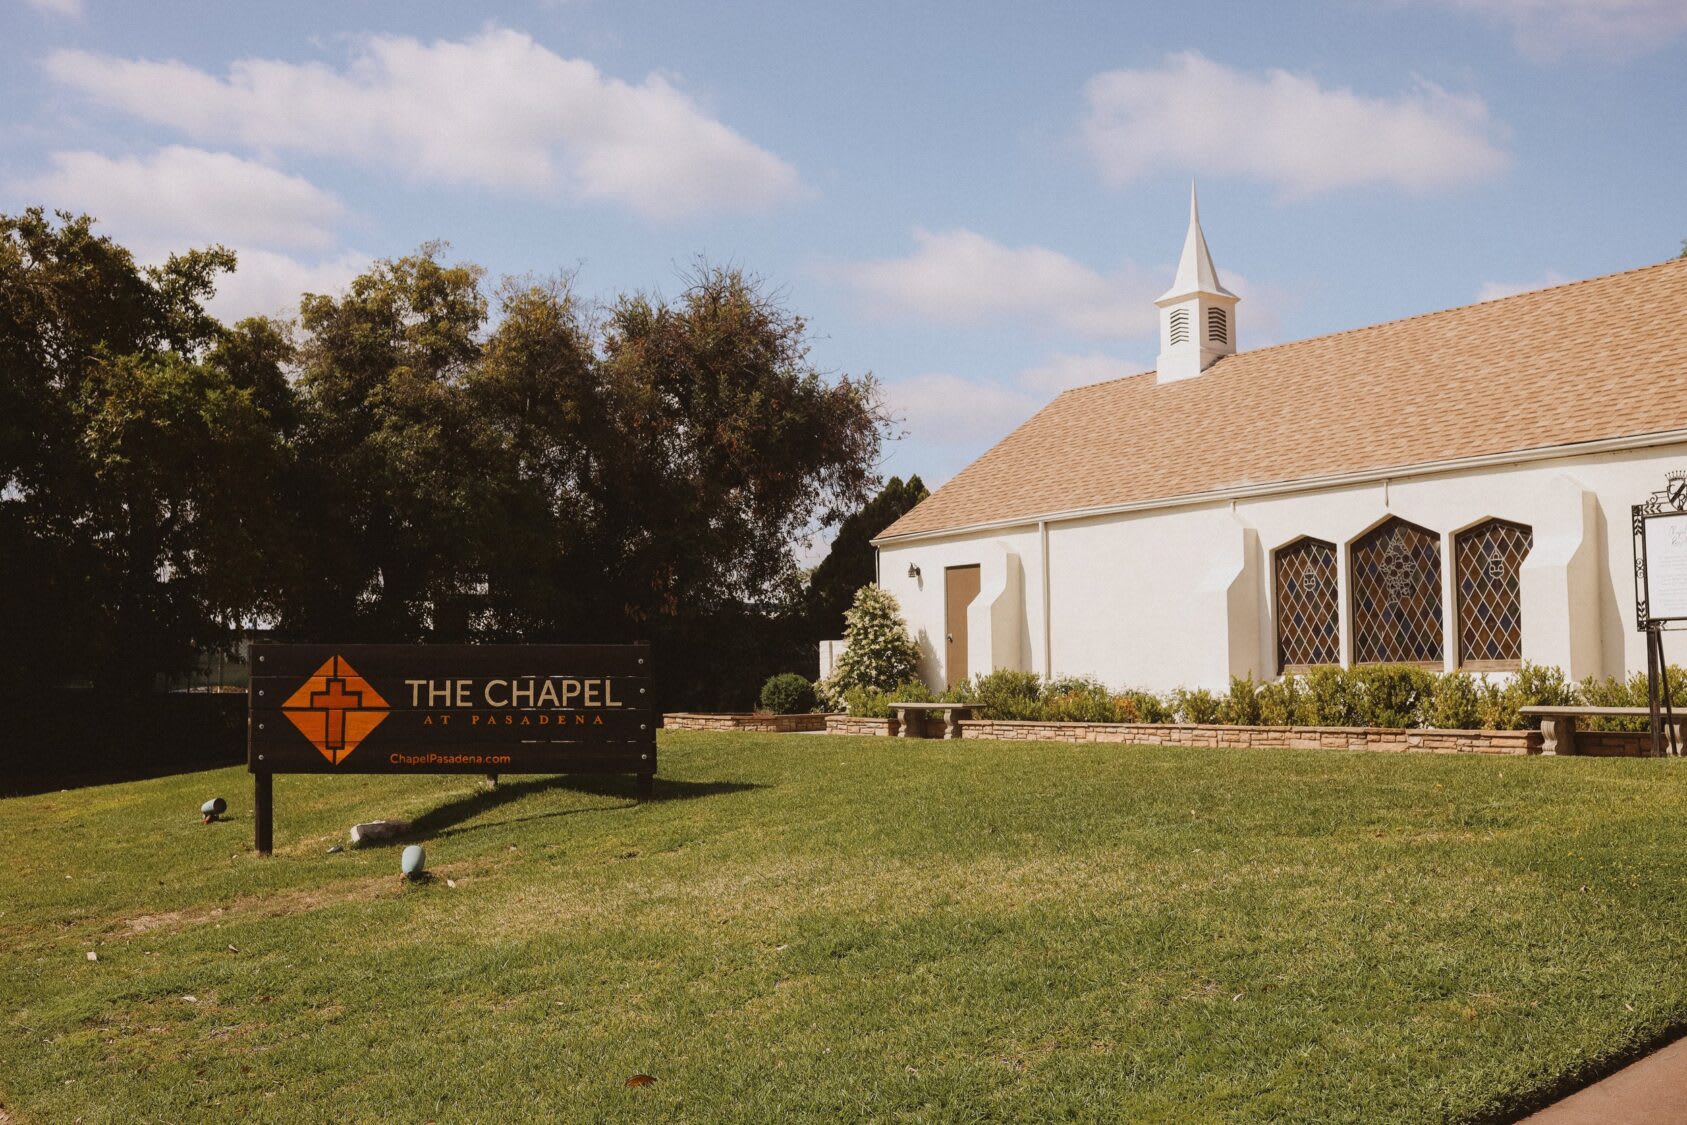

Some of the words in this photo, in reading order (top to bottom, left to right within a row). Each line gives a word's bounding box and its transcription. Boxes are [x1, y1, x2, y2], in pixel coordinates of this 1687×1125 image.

[404, 679, 473, 707] THE
[484, 679, 623, 707] CHAPEL
[424, 715, 450, 725] AT
[471, 715, 603, 725] PASADENA
[390, 753, 511, 764] ChapelPasadena.com
